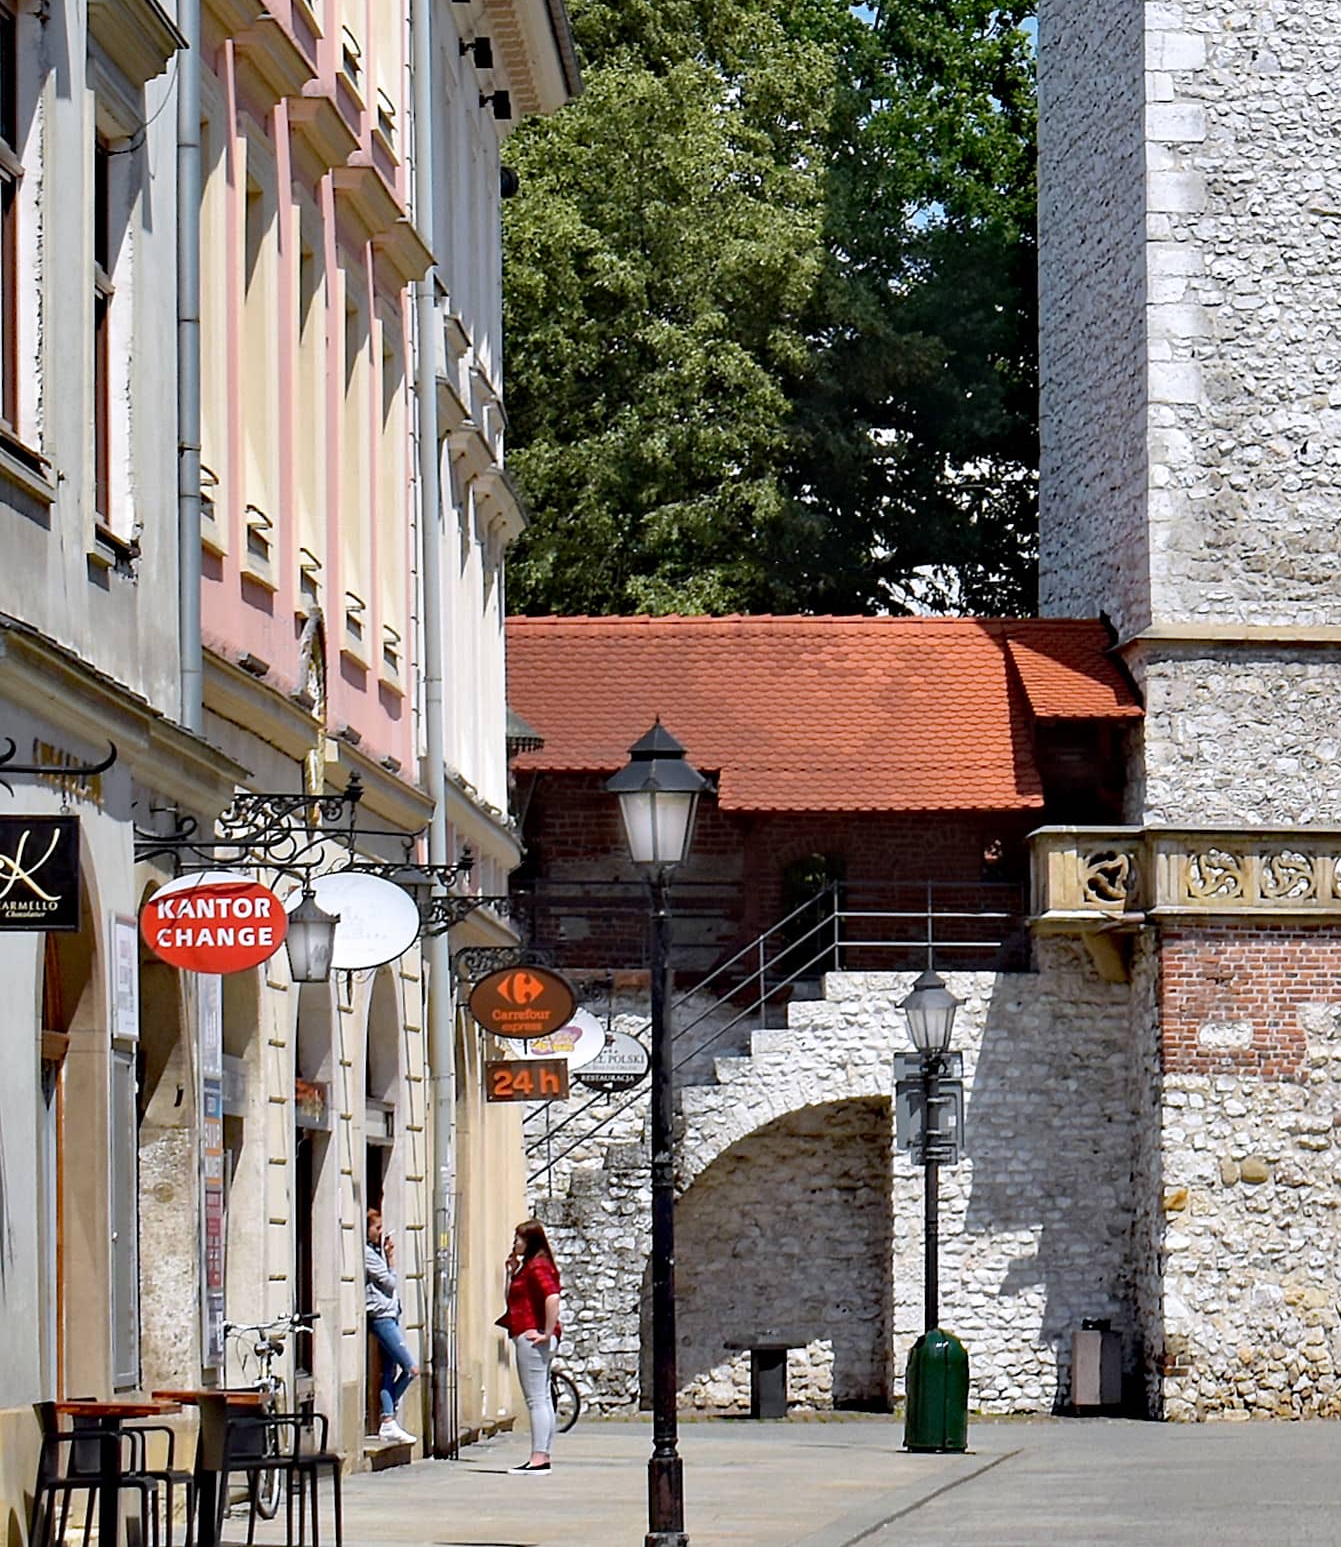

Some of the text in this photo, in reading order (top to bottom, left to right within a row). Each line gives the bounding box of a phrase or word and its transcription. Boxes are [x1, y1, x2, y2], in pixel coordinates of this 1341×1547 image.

[0, 900, 58, 912] ARMELLO
[157, 897, 271, 919] KANTOR
[157, 927, 273, 947] CHANGE
[491, 1008, 551, 1021] Carrefour
[608, 1055, 645, 1064] POLSKI
[493, 1069, 534, 1096] 24
[580, 1074, 635, 1082] RESTAURACJA
